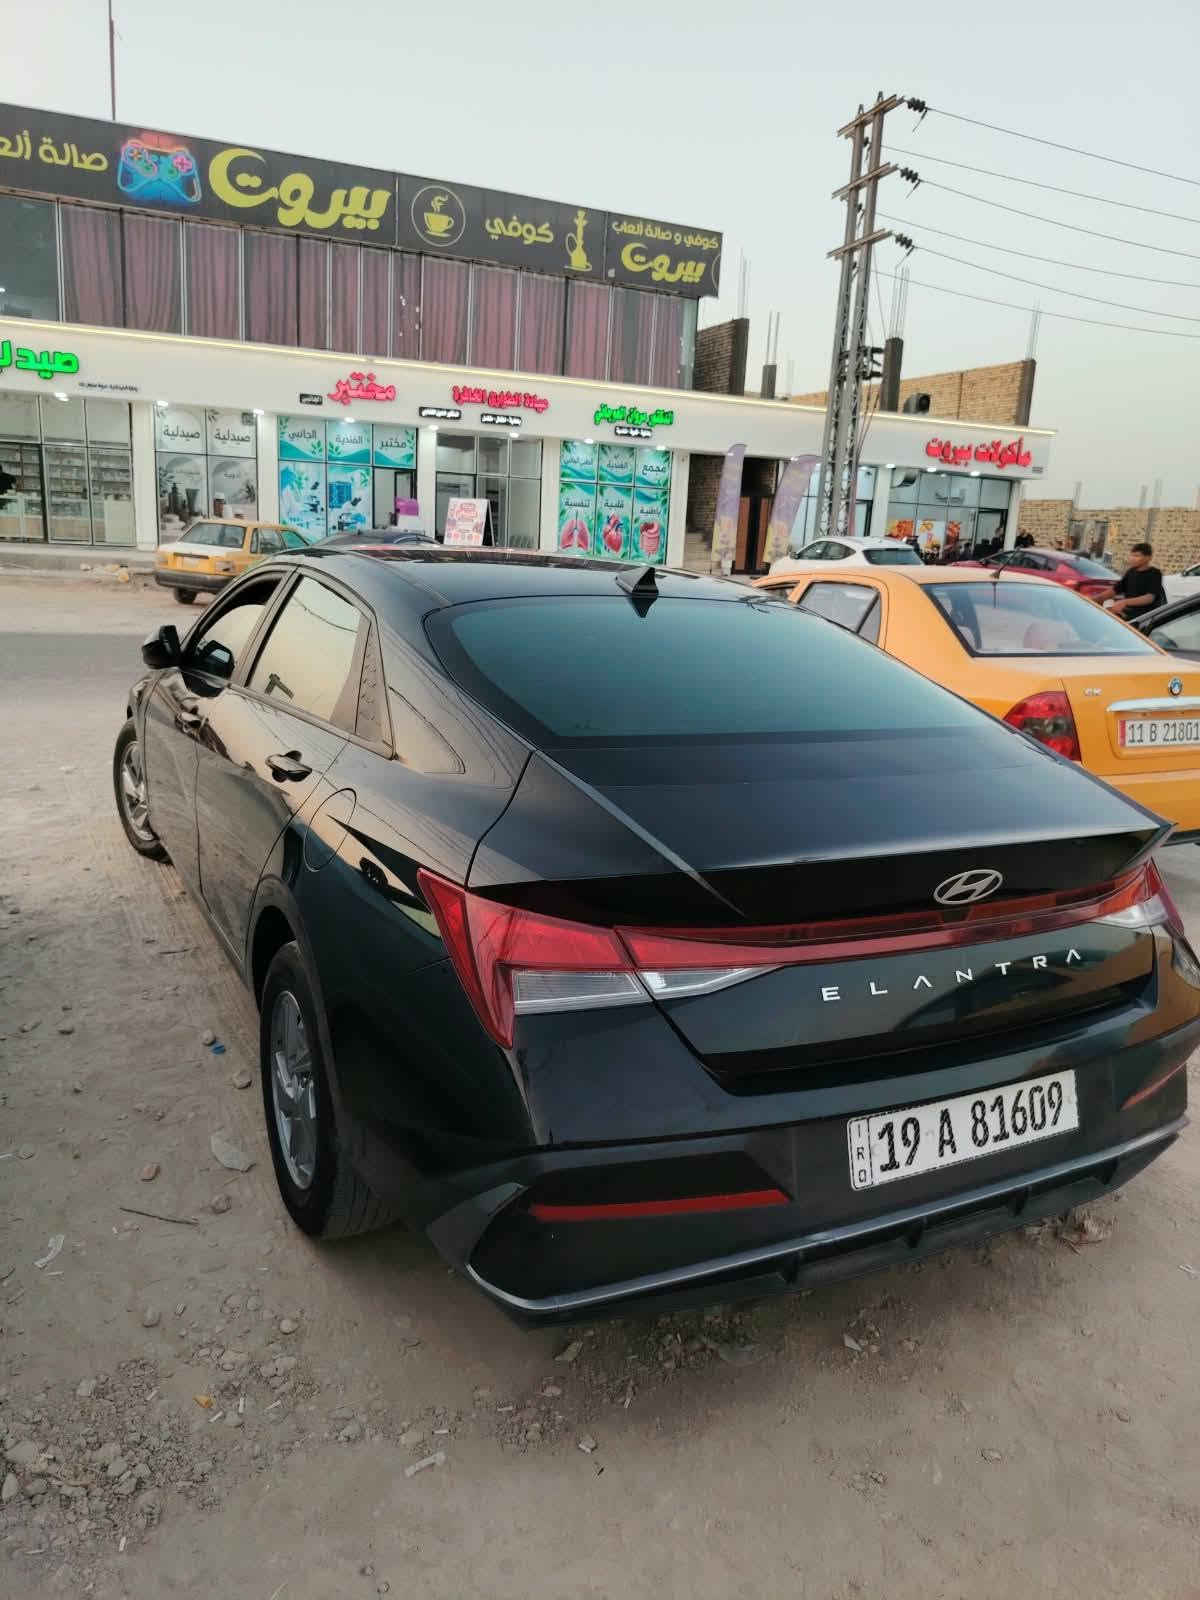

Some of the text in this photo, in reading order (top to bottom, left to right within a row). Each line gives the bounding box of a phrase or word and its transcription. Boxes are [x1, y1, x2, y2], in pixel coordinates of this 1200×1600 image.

[0, 130, 109, 172] صالة ألع
[208, 148, 391, 230] بيروت
[485, 215, 554, 245] كوفي
[644, 223, 673, 241] صالة
[673, 233, 682, 244] و
[684, 232, 719, 250] كوفي
[621, 242, 706, 283] بيروت
[327, 371, 397, 406] مختبر
[163, 424, 201, 442] صيدلية
[214, 428, 251, 445] صيدلية
[379, 435, 407, 450] مختبر
[925, 436, 1032, 469] مأكولات بيروت
[1128, 722, 1200, 743] 11 B 21801
[821, 948, 1082, 1003] ELANTRA
[876, 1080, 1064, 1172] 19 A 81609
